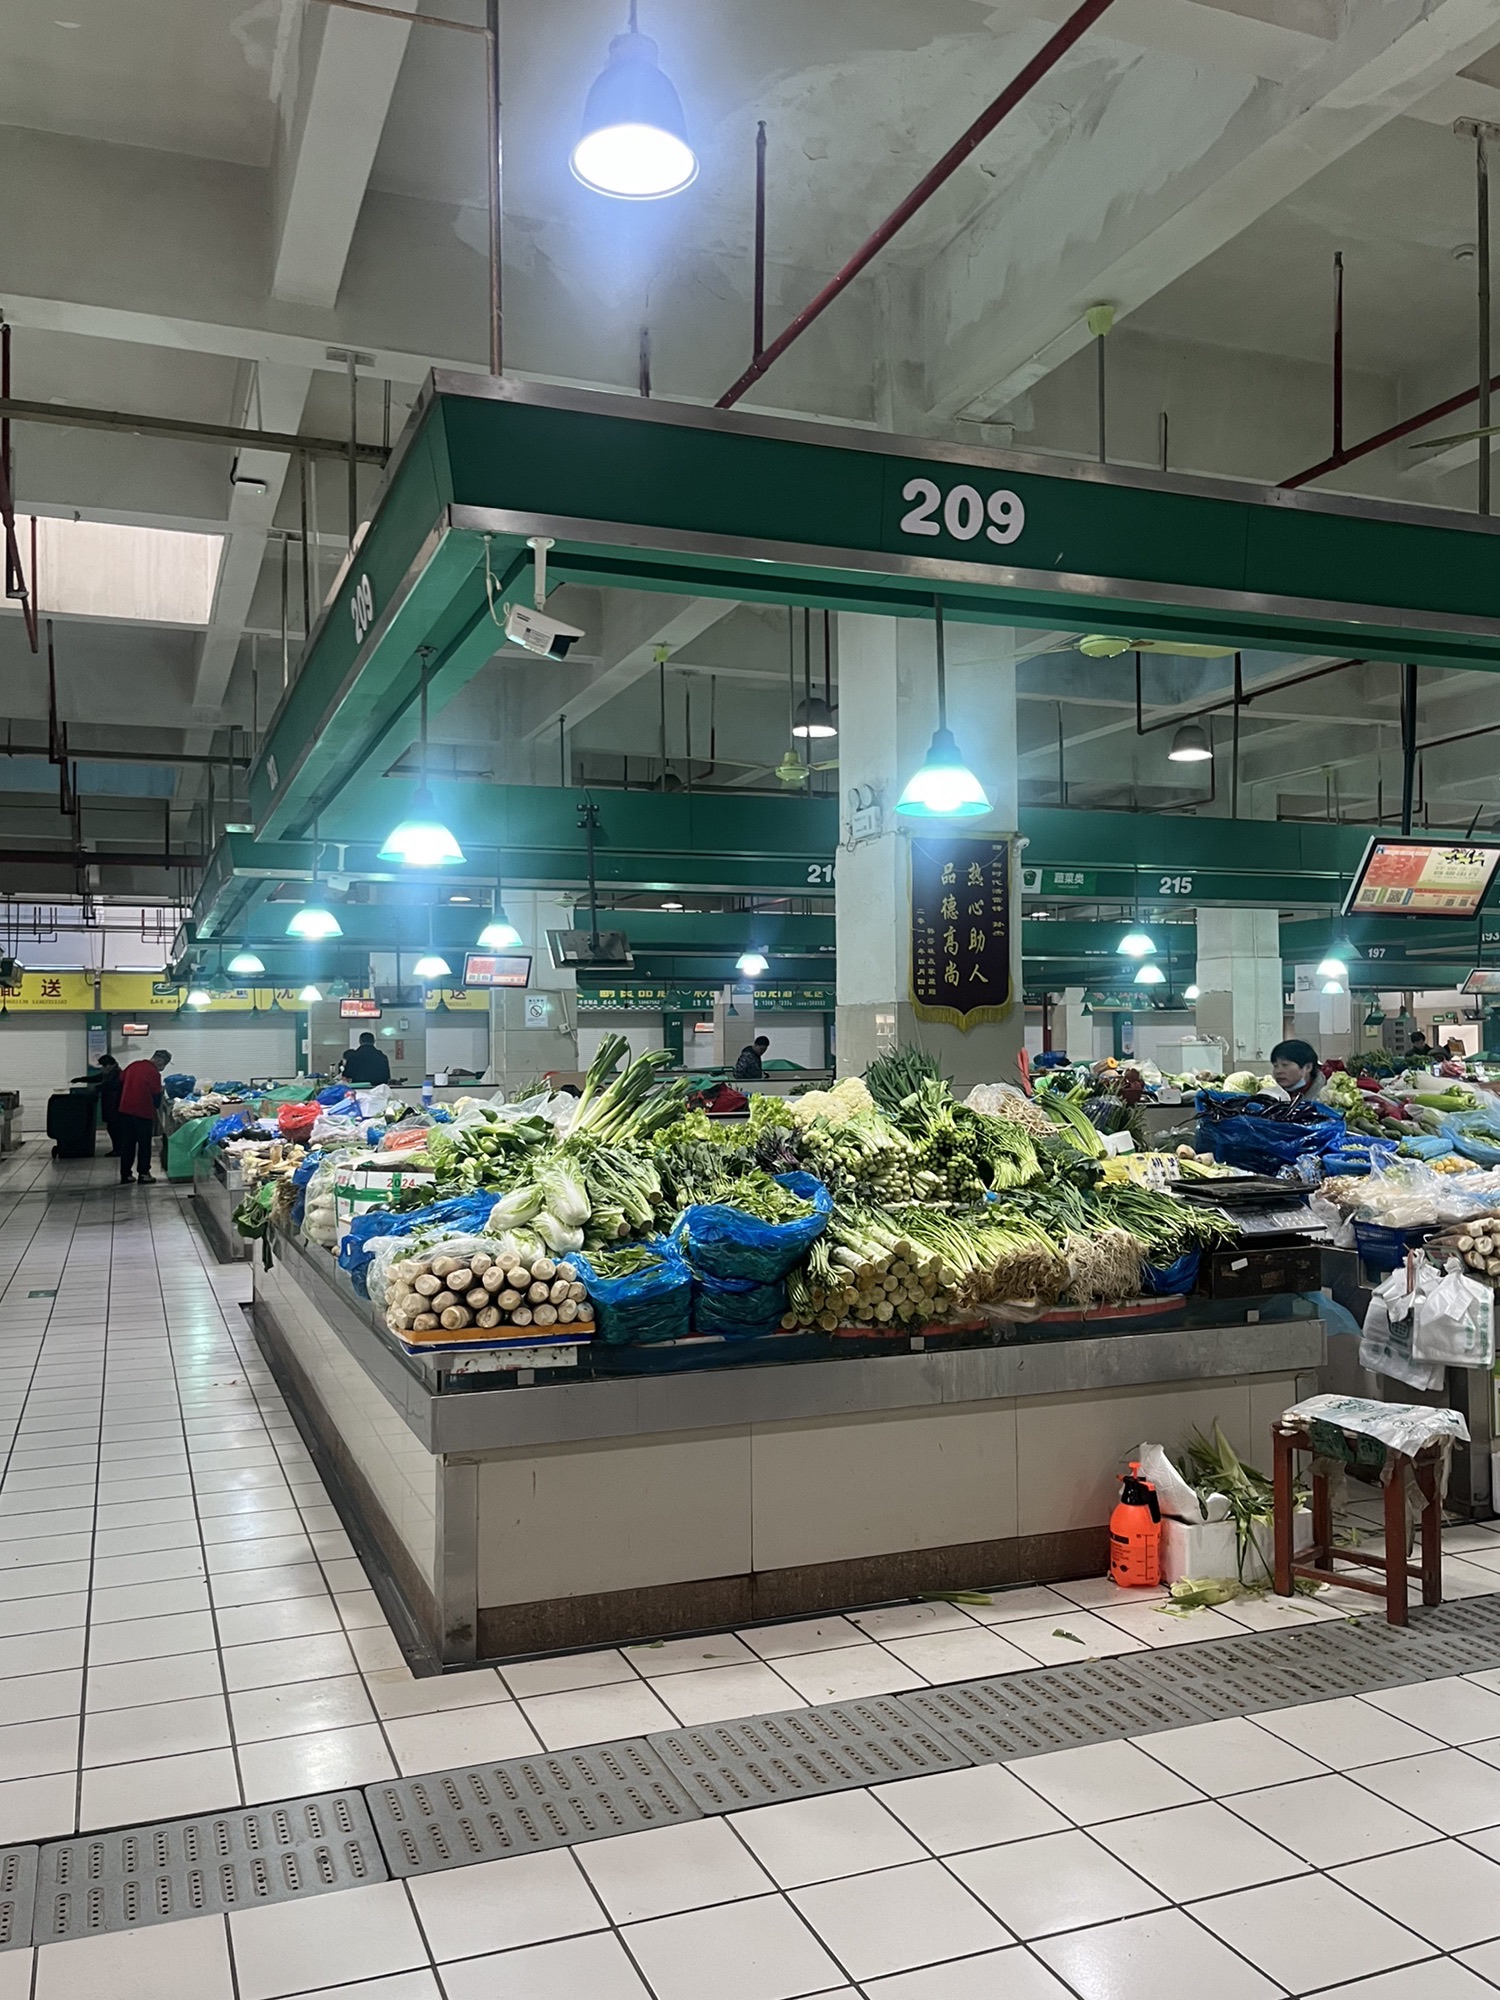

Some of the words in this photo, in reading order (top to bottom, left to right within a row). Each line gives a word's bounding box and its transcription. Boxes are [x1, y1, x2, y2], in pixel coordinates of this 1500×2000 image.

[900, 478, 1025, 545] 209
[350, 573, 374, 645] 209
[807, 864, 836, 883] 21
[1159, 876, 1193, 894] 215
[941, 862, 960, 987] 品德高尚
[967, 862, 989, 985] 热心助人
[1367, 947, 1386, 958] 197
[386, 1178, 416, 1188] 2024
